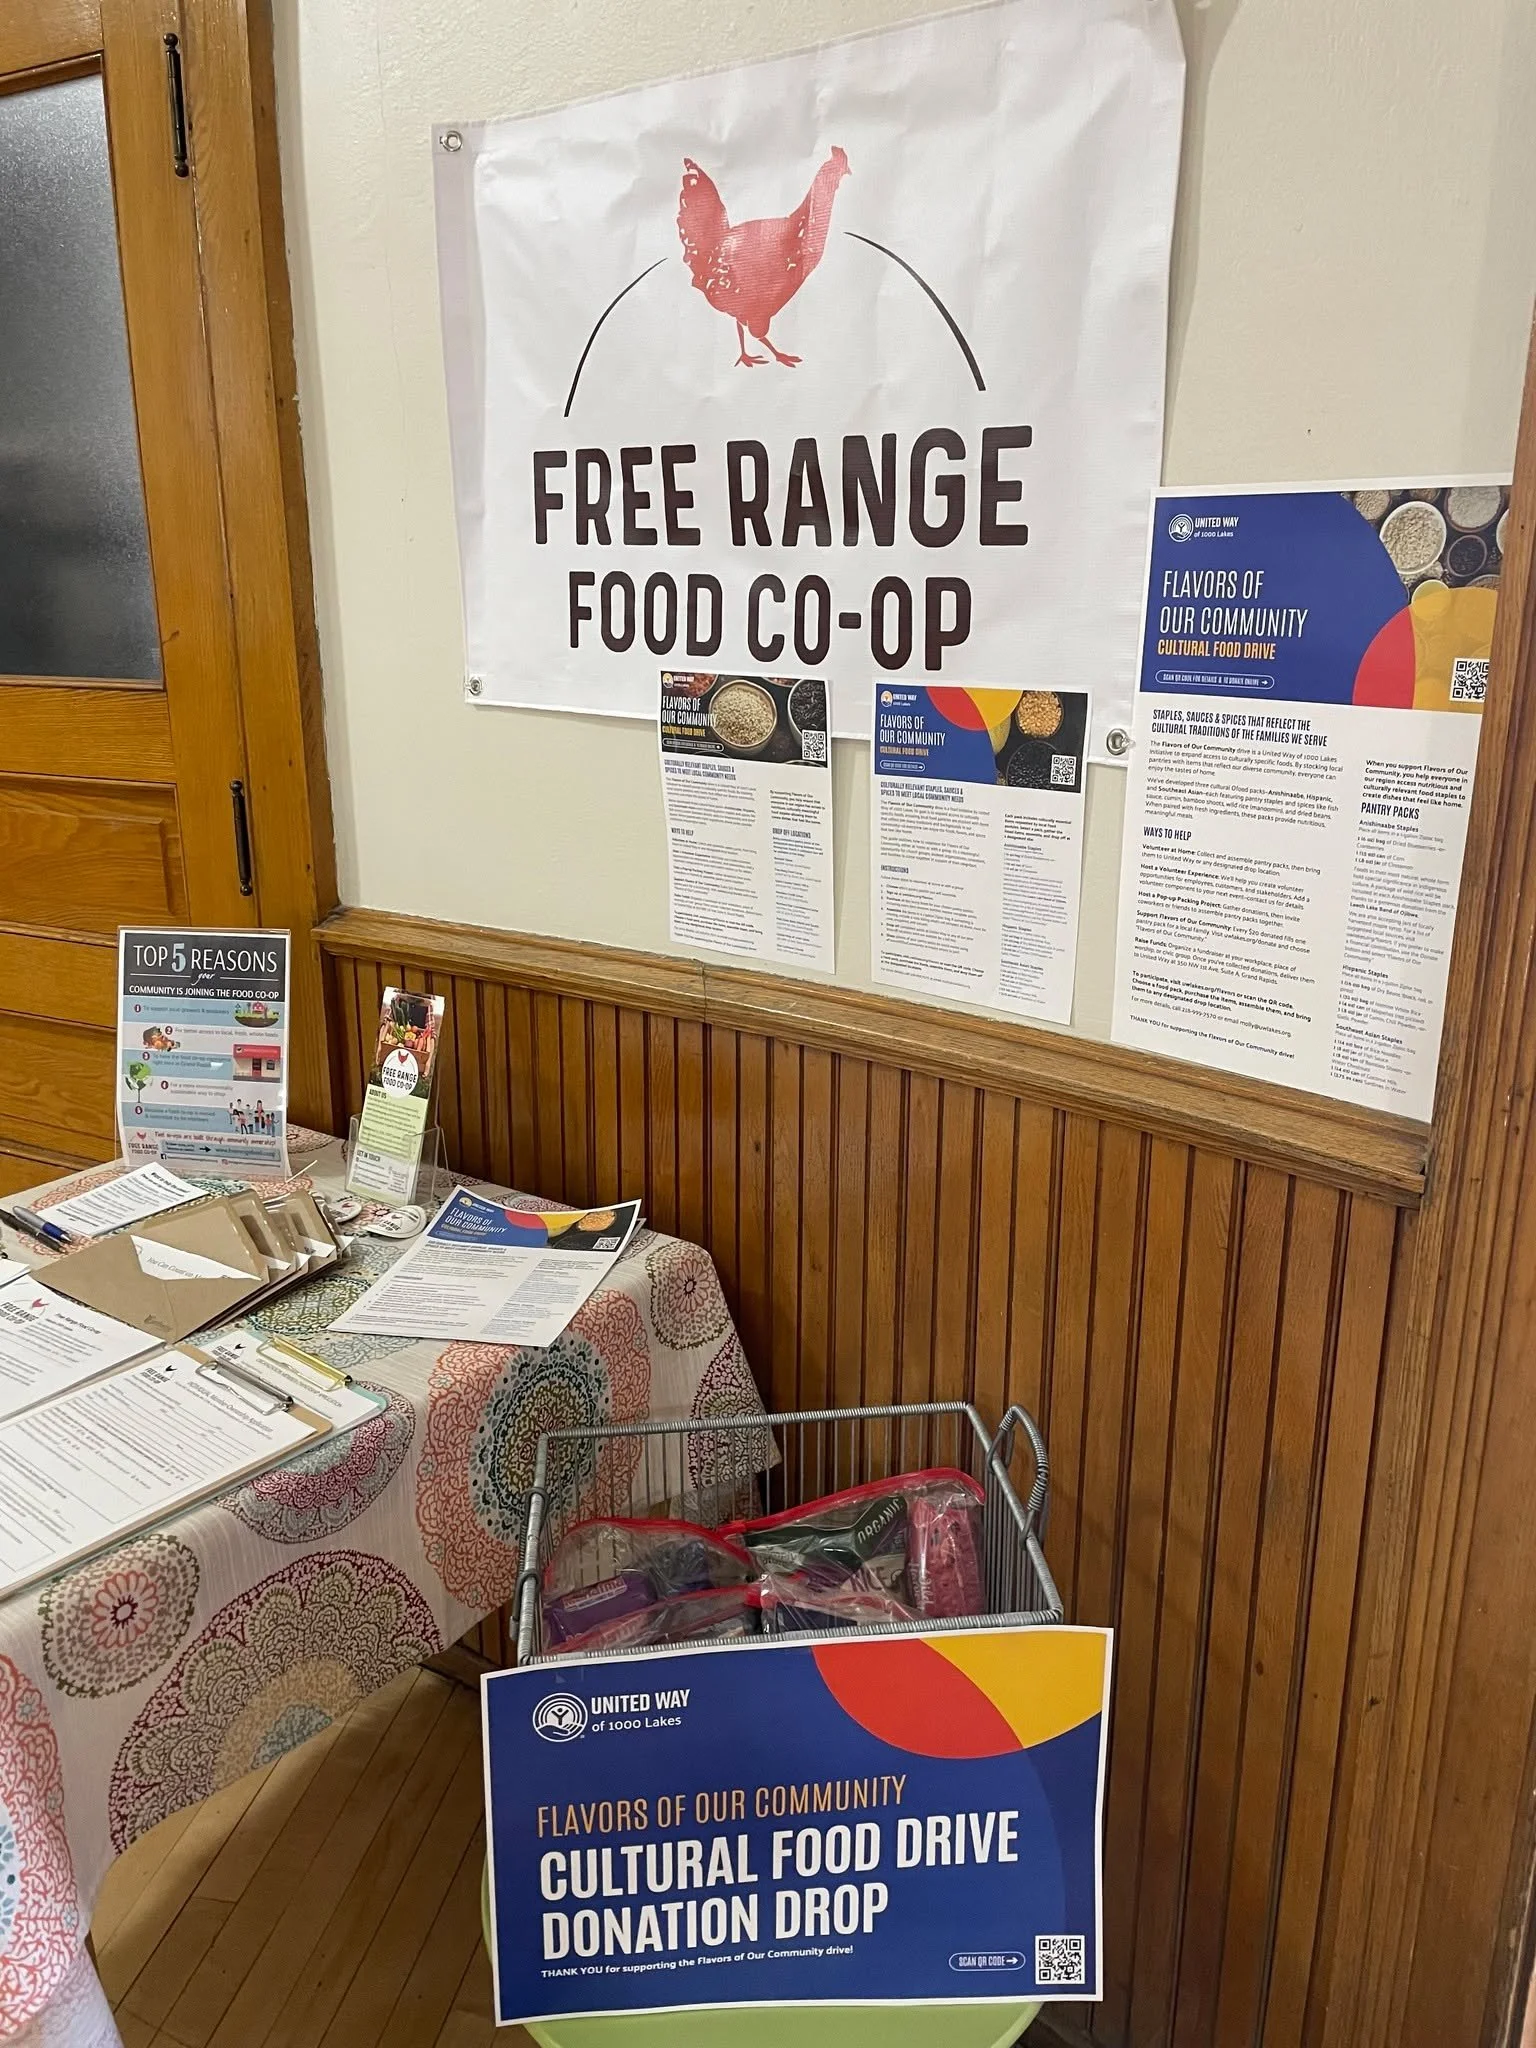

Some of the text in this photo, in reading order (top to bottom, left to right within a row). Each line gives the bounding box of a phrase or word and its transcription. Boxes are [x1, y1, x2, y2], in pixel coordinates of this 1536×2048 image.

[533, 425, 1033, 548] FREE RANGE
[1194, 517, 1239, 528] UNITED WAY
[1163, 570, 1265, 599] FLAVORS OF
[569, 571, 972, 671] FOOD CO-OP
[1160, 606, 1308, 638] OUR COMMUNITY
[1158, 639, 1276, 660] CULTURAL FOOD DRIVE
[663, 696, 701, 712] FLAVORS OF
[662, 710, 718, 727] OUR COMMUNITY
[880, 714, 924, 730] FLAVORS OF
[1153, 709, 1311, 731] STAPLES, SAUCES & SPICES THAT REFLECT THE
[880, 729, 945, 746] OUR COMMUNITY
[1151, 722, 1327, 746] CULTURAL TRADITIONS OF THE FAMILIES WE SERVE
[1203, 744, 1236, 753] Community
[1365, 767, 1401, 777] Community,
[1363, 784, 1391, 792] culturally
[1361, 802, 1419, 819] PANTRY PACKS
[1143, 826, 1192, 840] WAYS TO HELP
[1396, 824, 1419, 832] Staples
[133, 943, 278, 972] TOP 5 REASONS
[1342, 965, 1388, 978] Hispanic Staples
[129, 985, 175, 995] COMMUNITY
[185, 988, 214, 997] JOINING
[216, 989, 230, 998] THE
[232, 989, 253, 998] FOOD
[255, 990, 279, 999] CO-OP
[1381, 1034, 1403, 1044] Staples
[383, 1067, 417, 1083] FREE RANGE
[384, 1077, 412, 1090] FOOD CO-OP
[445, 1215, 461, 1226] OUR
[462, 1222, 507, 1233] COMMUNITY
[450, 1208, 483, 1224] FLAVORS
[857, 1498, 904, 1544] ORGANIC
[590, 1689, 691, 1714] UNITED WAY
[591, 1716, 682, 1731] of 1000 Lakes
[538, 1775, 907, 1837] FLAVORS OF OUR COMMUNITY
[540, 1810, 1020, 1901] CULTURAL FOOD DRIVE
[543, 1882, 890, 1960] DONATION DROP
[540, 1944, 855, 1978] THANK YOU for supporting the Flavors of Our Community drive!
[958, 1952, 1006, 1970] SCAN QR CODE
